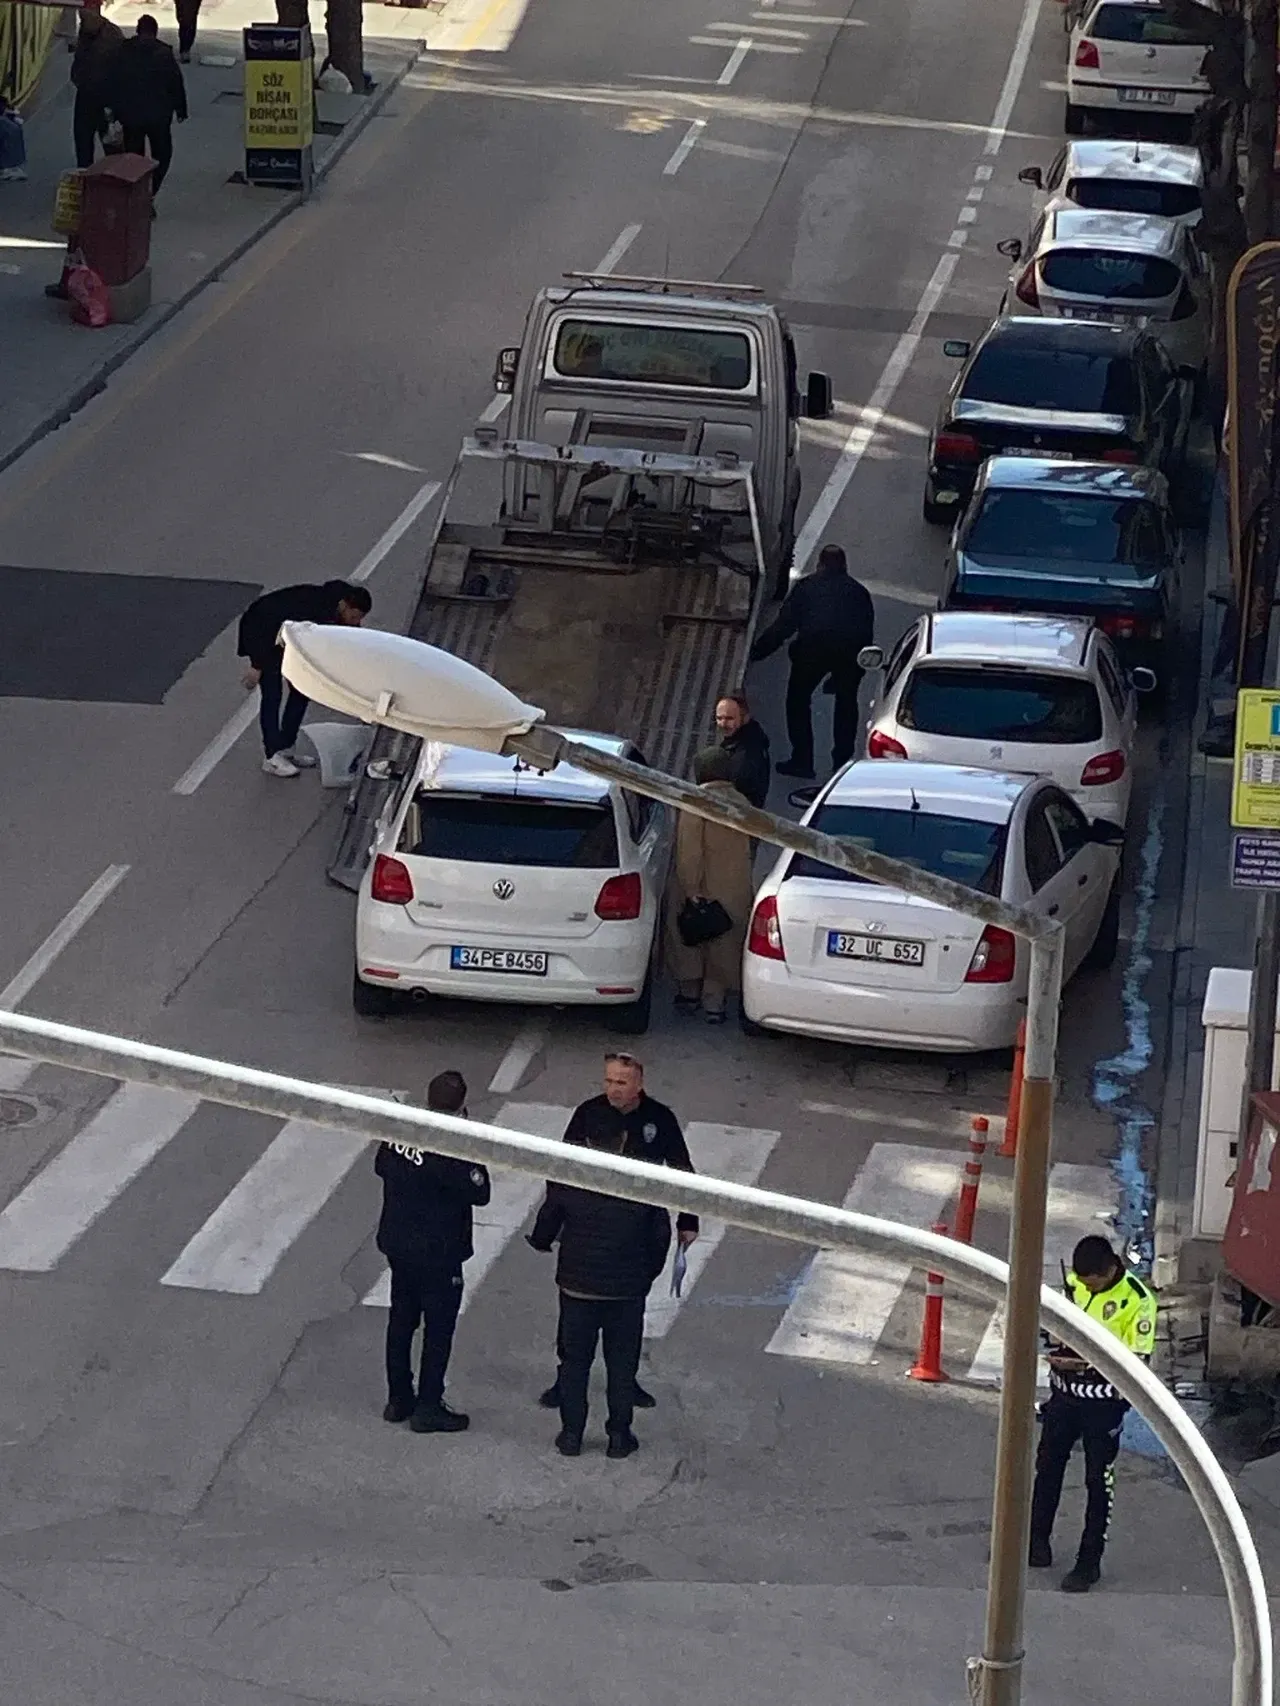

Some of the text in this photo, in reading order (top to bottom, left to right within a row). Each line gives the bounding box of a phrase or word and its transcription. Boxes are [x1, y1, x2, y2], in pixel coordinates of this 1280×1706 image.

[263, 72, 284, 87] SÖZ
[250, 107, 298, 122] BOHÇASI
[838, 936, 920, 961] 32 UC 652
